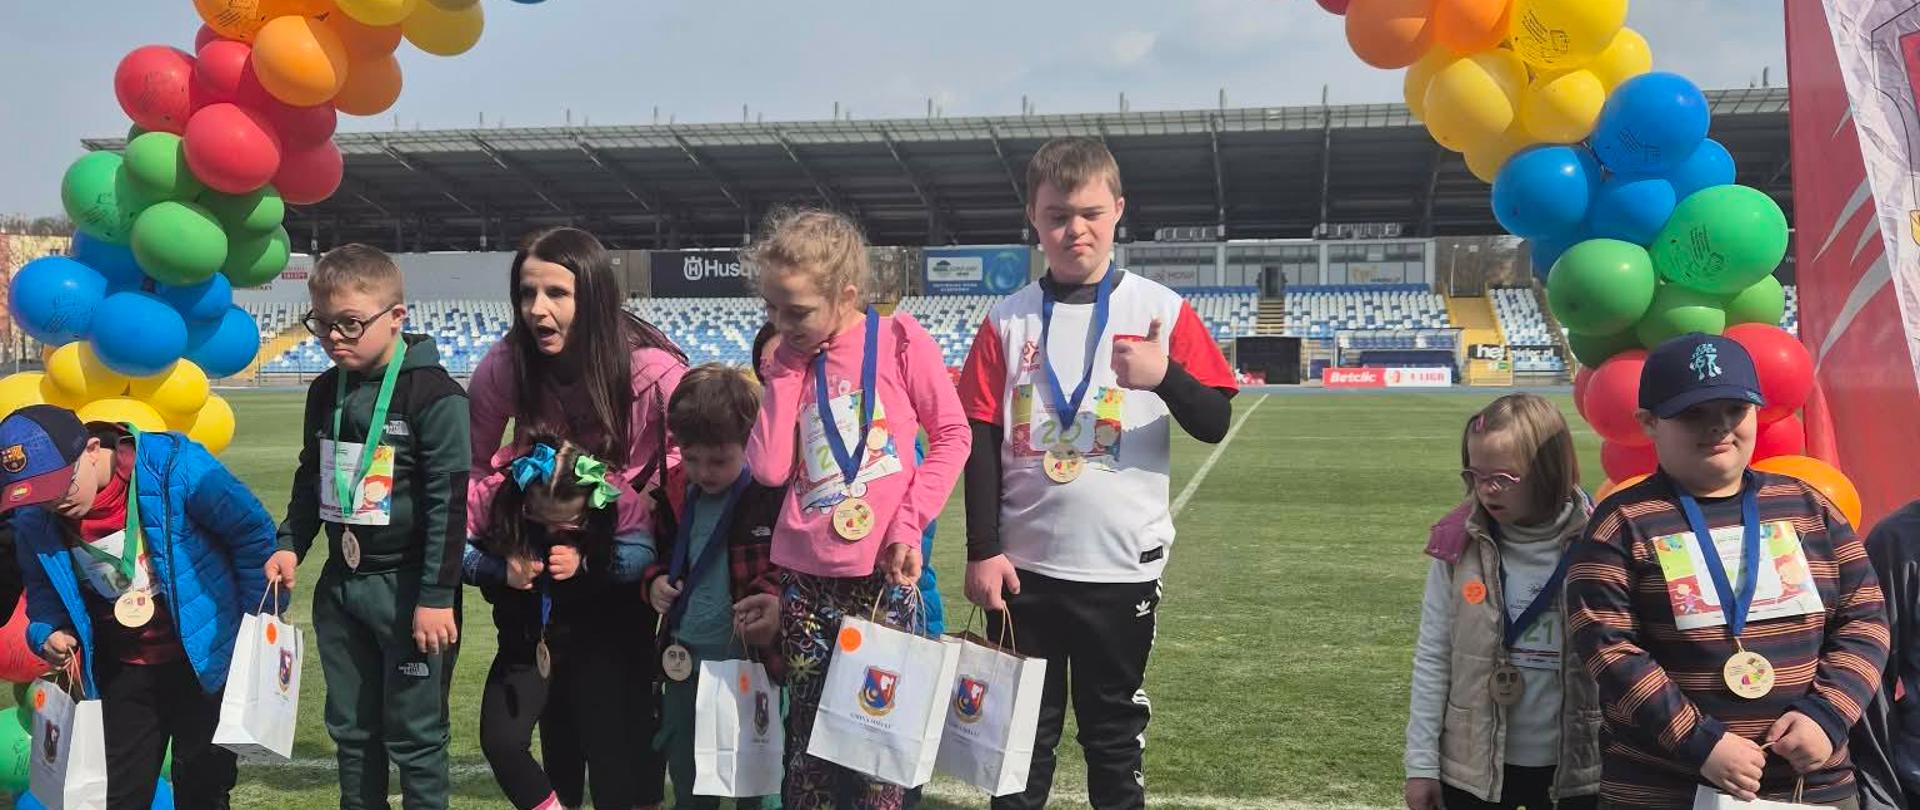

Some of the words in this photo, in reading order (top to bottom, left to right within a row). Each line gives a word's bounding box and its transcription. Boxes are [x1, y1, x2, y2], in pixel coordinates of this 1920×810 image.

[704, 259, 761, 280] Husqv
[1330, 371, 1377, 384] Betclic
[815, 444, 834, 471] 2
